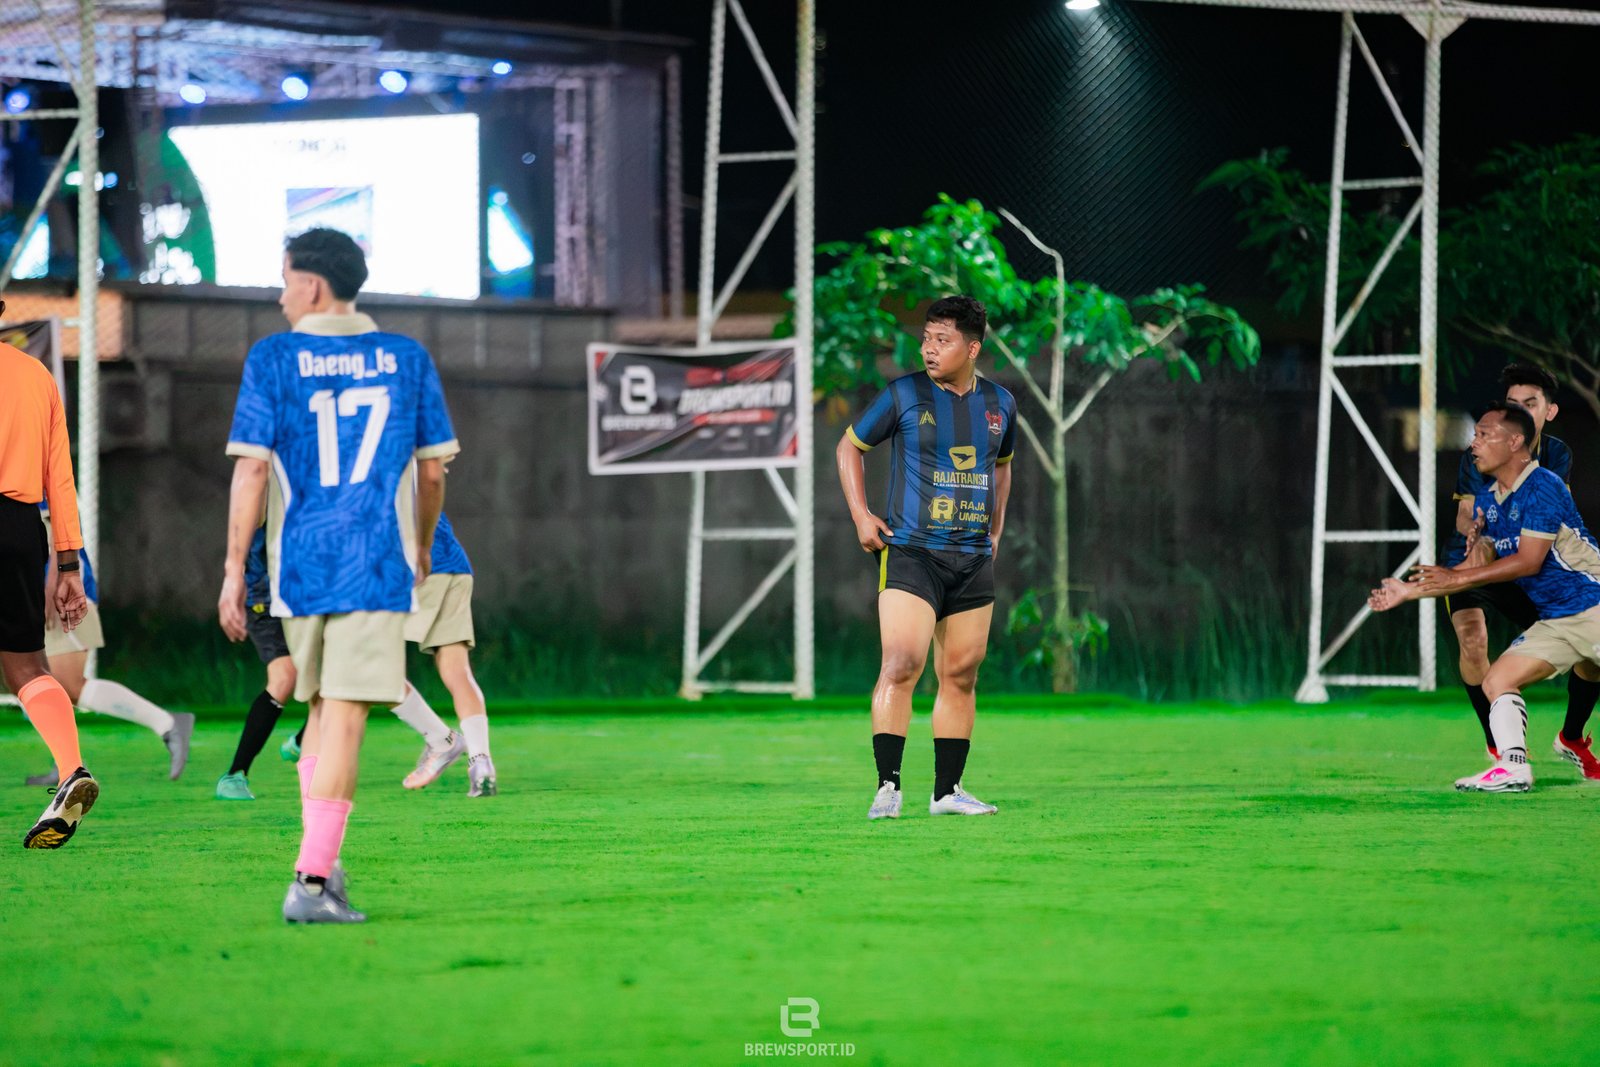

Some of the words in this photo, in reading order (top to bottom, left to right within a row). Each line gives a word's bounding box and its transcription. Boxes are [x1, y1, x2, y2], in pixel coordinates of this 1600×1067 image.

[308, 386, 391, 486] 17
[933, 471, 988, 486] RAJATRANSIT
[960, 500, 985, 511] RAJA
[959, 512, 989, 523] UMROH
